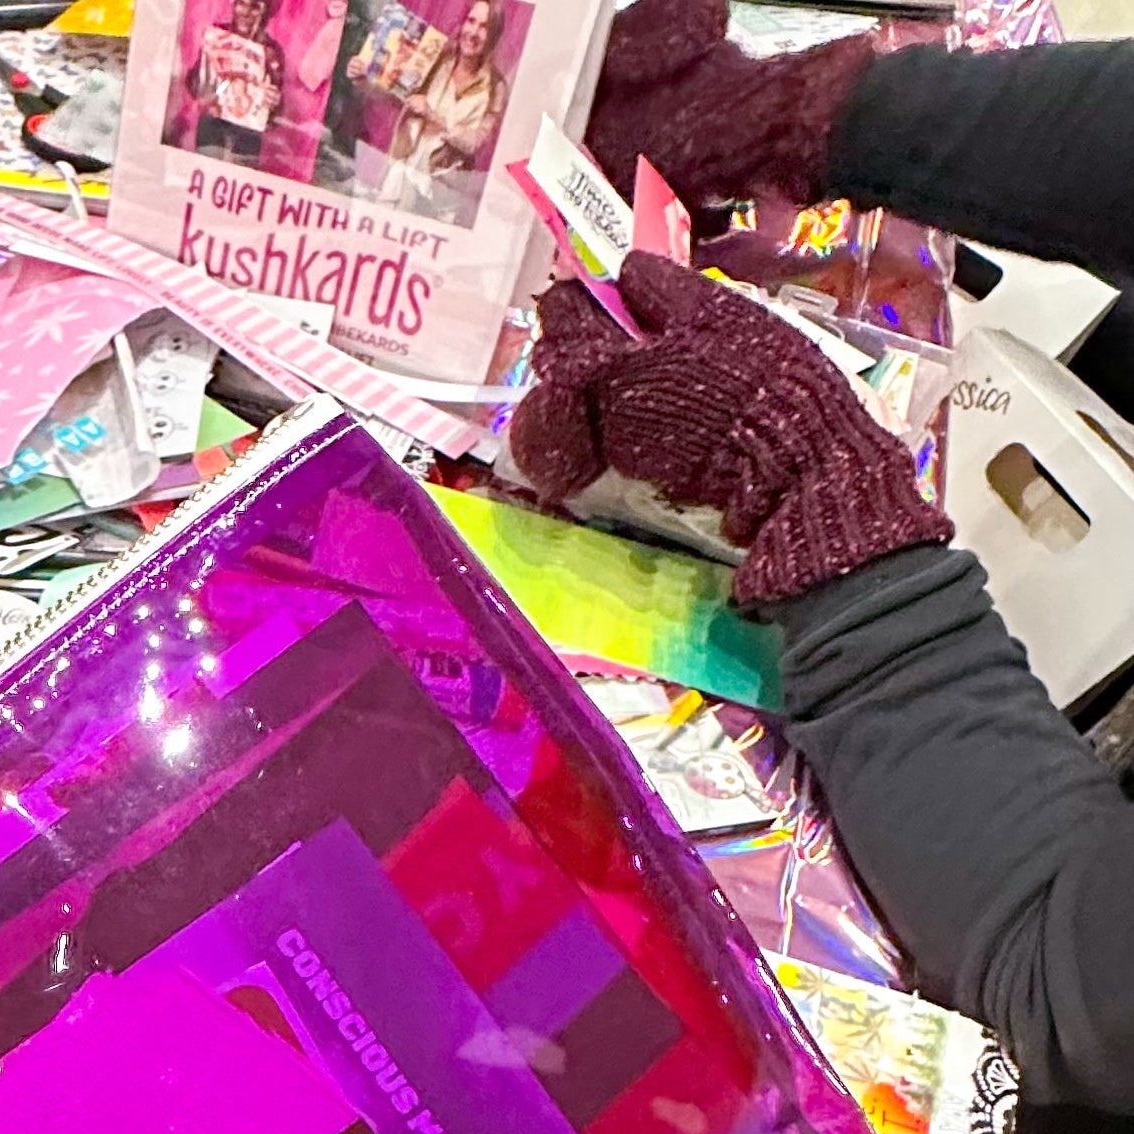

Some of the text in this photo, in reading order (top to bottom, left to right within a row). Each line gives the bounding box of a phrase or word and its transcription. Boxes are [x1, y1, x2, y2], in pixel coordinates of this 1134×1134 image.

[188, 169, 449, 261] A GIFT WITH A LIFT
[276, 928, 420, 1114] CONSCIOUS
